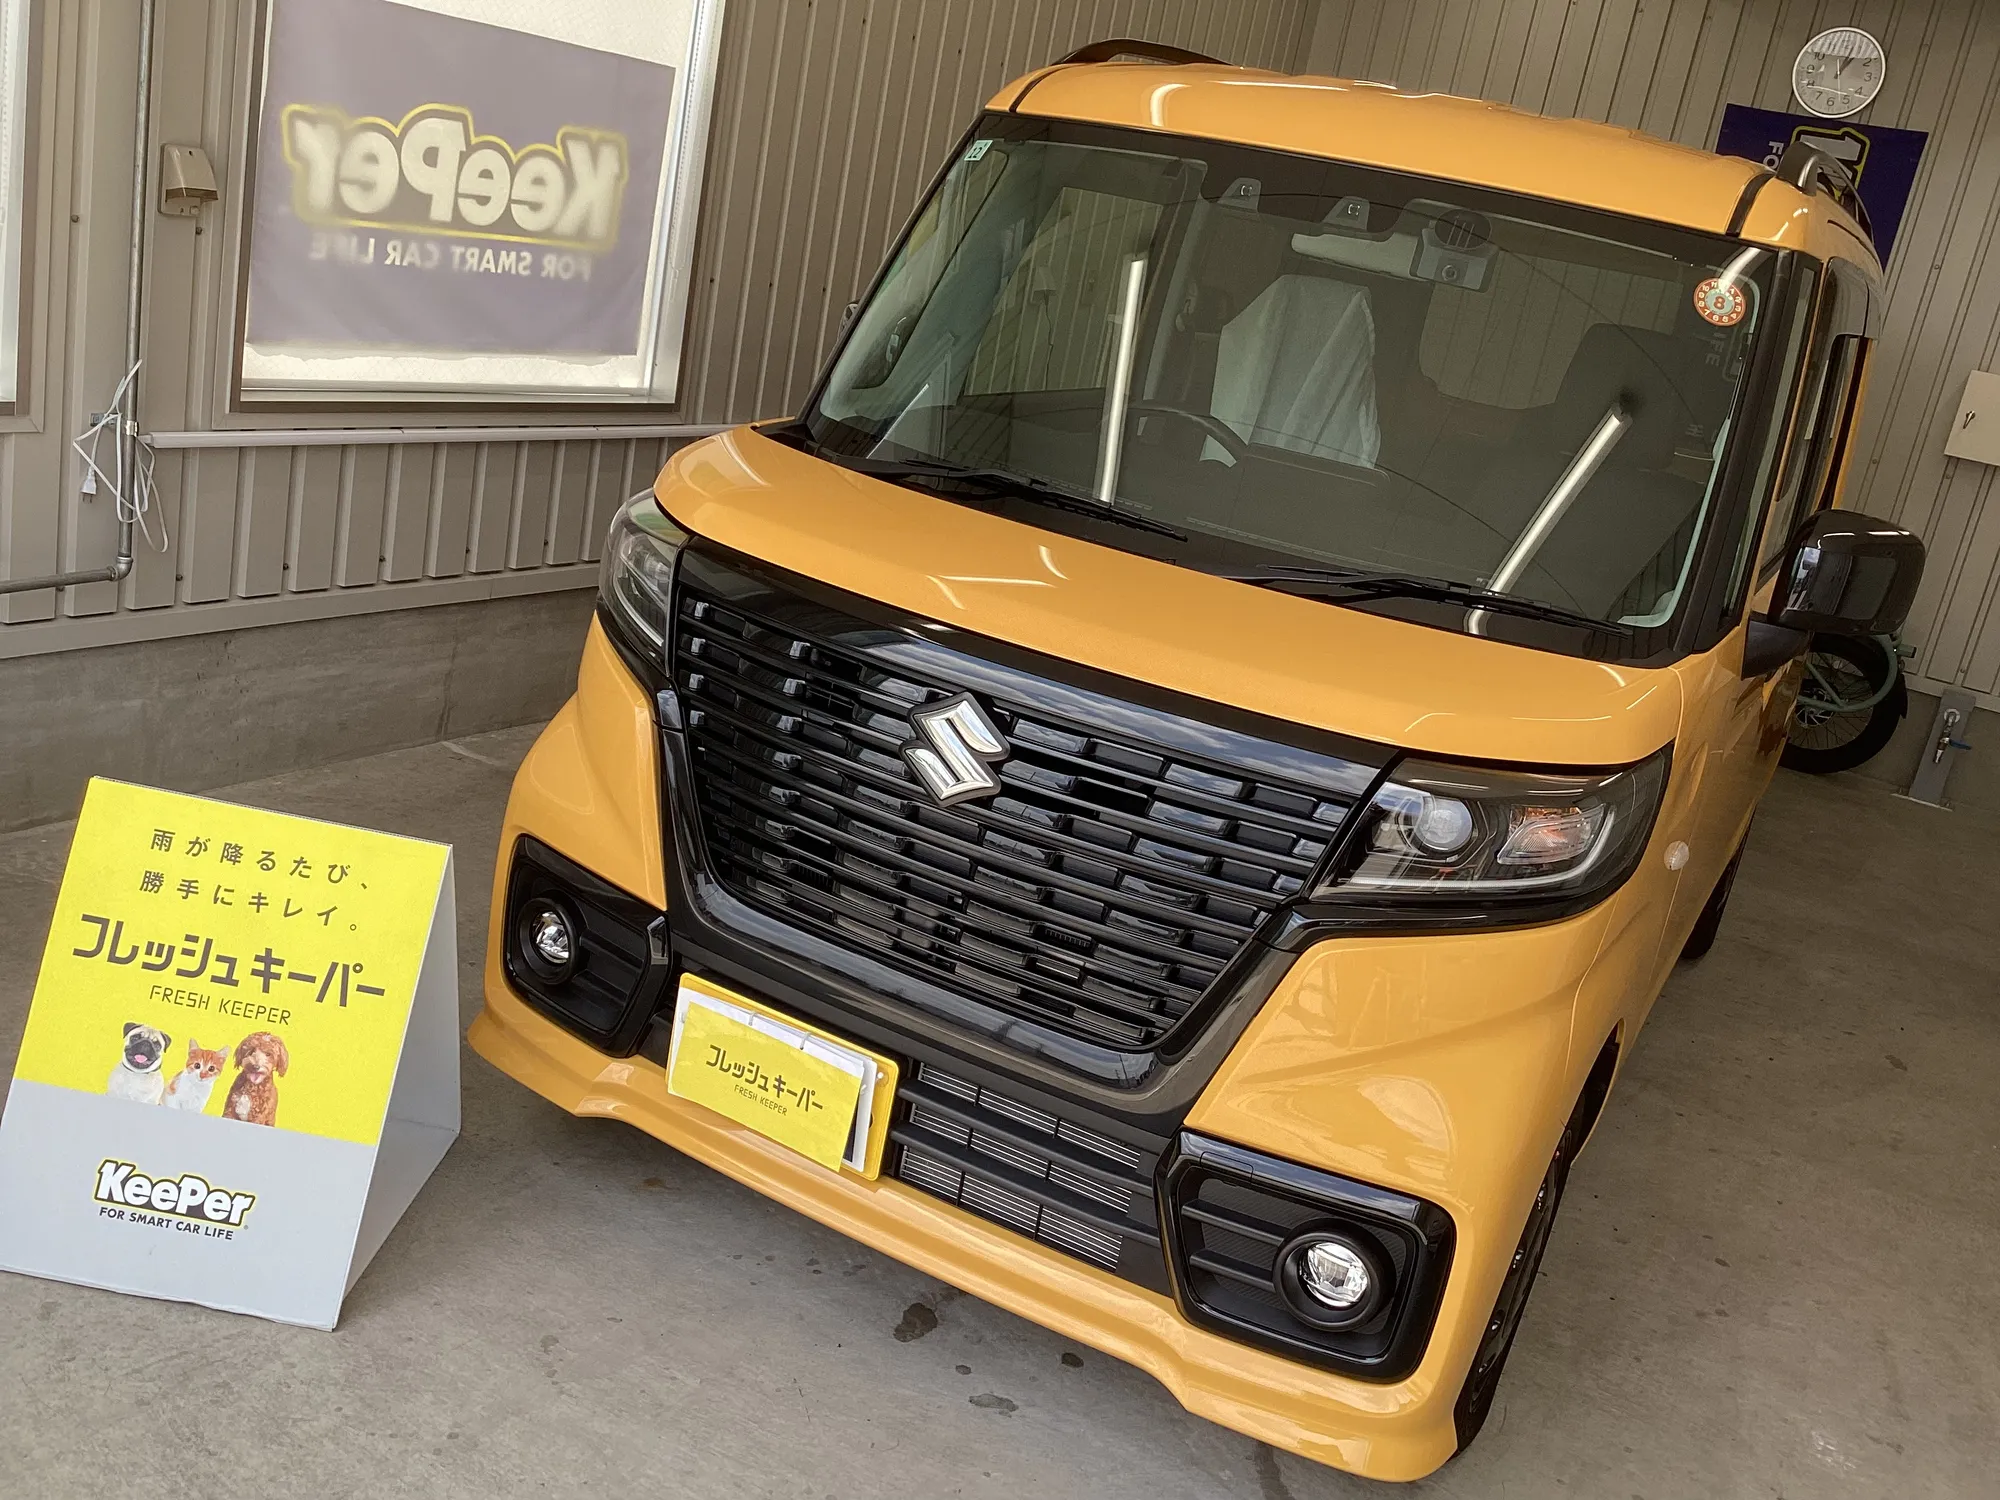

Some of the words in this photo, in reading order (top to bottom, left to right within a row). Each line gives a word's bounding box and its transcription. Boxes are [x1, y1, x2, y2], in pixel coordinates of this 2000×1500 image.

[1806, 64, 1815, 74] 9
[1862, 57, 1872, 67] 2
[1854, 86, 1863, 96] 4
[1863, 72, 1873, 82] 3
[1814, 91, 1823, 101] 7
[1826, 96, 1836, 107] 6
[1842, 94, 1851, 105] 5
[1763, 141, 1784, 170] FO
[1714, 296, 1726, 310] 8
[150, 828, 368, 890] 雨が降るたび、
[139, 870, 357, 931] 勝手にキレイ。
[72, 913, 386, 1008] フレッシュキーパー
[149, 984, 211, 1011] FRESH
[218, 999, 292, 1026] KEEPER
[706, 1044, 824, 1112] フレッシュキーパー
[734, 1084, 758, 1101] FRESH
[759, 1097, 788, 1116] KEEPER
[95, 1159, 256, 1227] KeePer
[99, 1206, 125, 1221] FOR
[129, 1212, 172, 1229] SMART
[175, 1221, 201, 1235] CAR
[204, 1226, 234, 1241] LIFE
